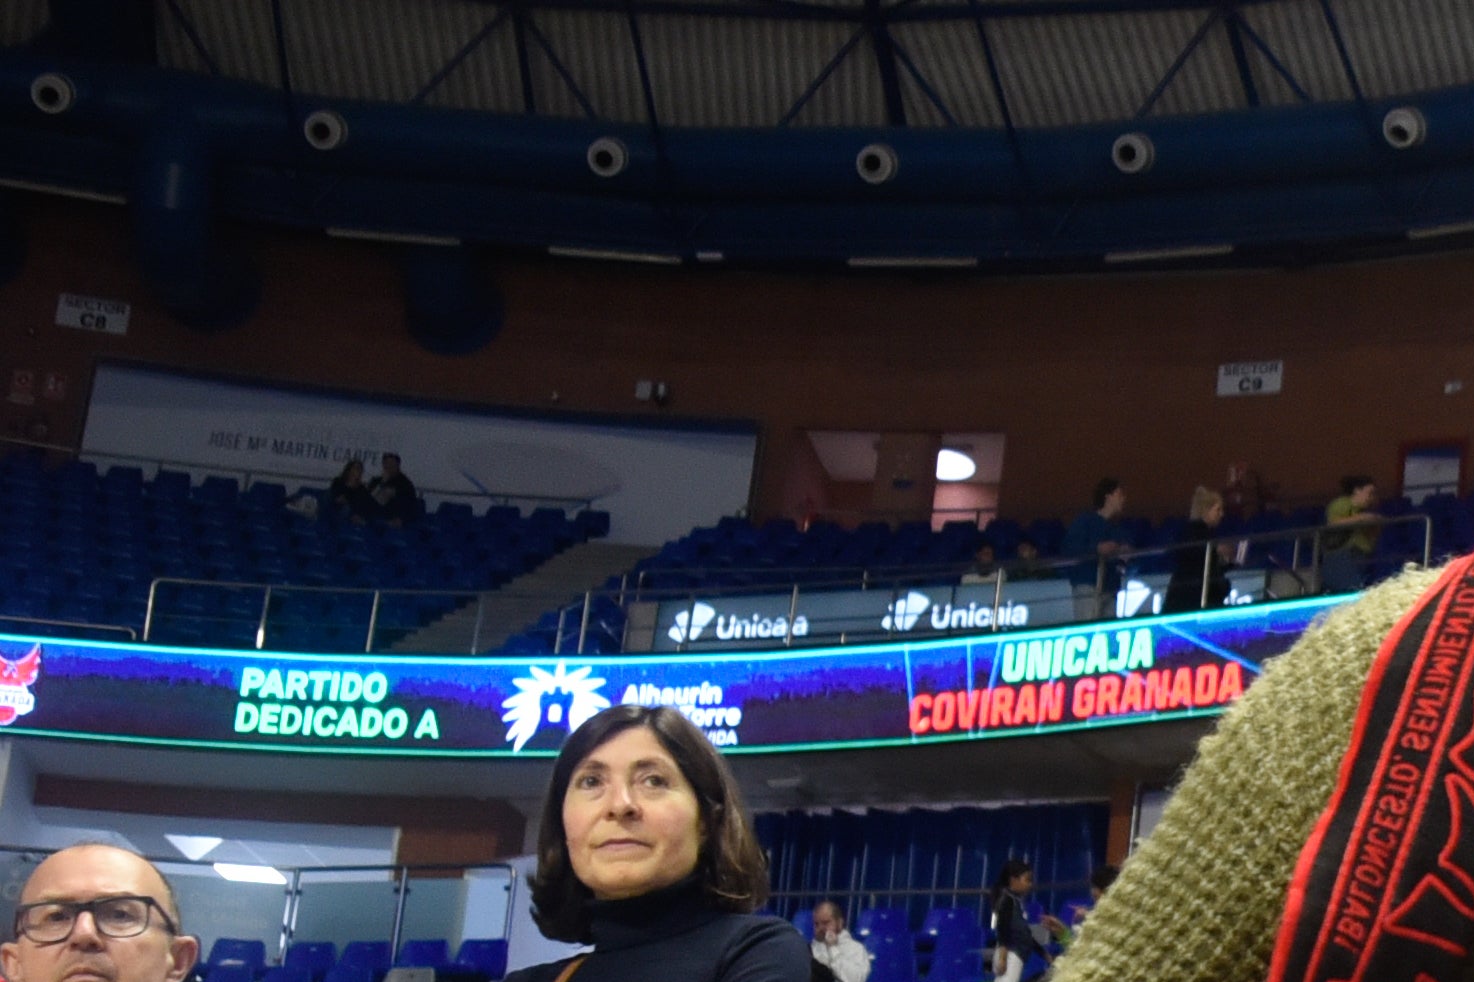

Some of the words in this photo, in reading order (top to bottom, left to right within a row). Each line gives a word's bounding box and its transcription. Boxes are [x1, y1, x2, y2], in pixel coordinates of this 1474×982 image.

[716, 613, 808, 643] Unicaa
[1002, 629, 1155, 683] UNICAJA
[240, 667, 388, 703] PARTIDO
[909, 682, 1065, 734] COVIRAN
[1072, 662, 1244, 718] GRANADA
[234, 702, 409, 739] DEDICADO
[414, 708, 439, 739] A
